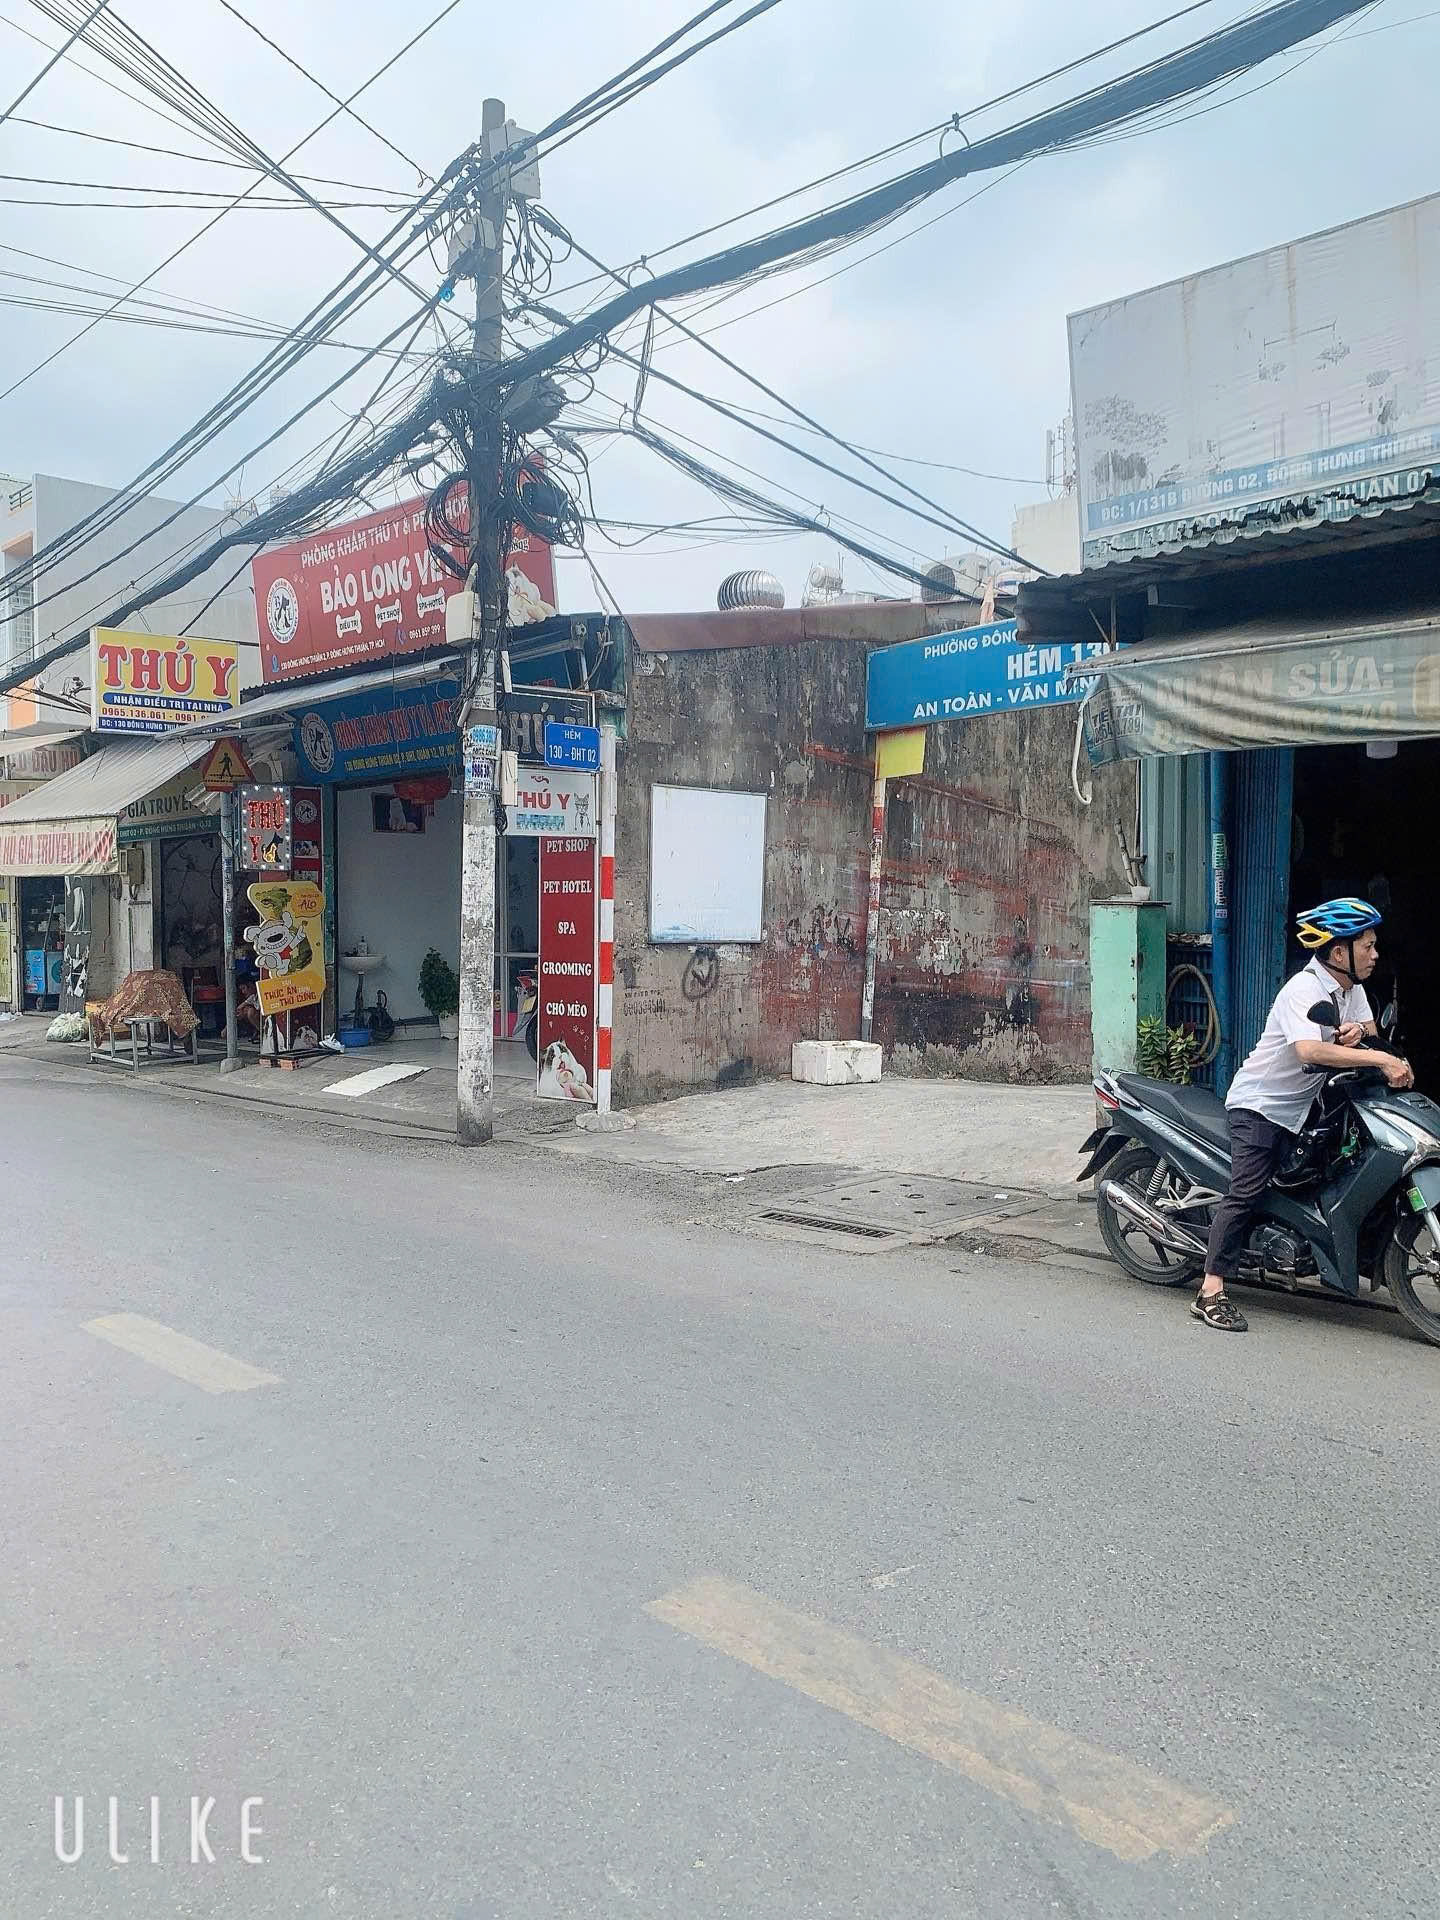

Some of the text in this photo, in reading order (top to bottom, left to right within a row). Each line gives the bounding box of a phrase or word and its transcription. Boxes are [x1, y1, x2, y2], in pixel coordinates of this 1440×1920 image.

[392, 520, 401, 537] Y
[319, 563, 359, 614] BẢO
[359, 555, 413, 603] LONG
[923, 636, 978, 659] PHƯỜNG
[98, 640, 237, 699] THÚ Y
[1007, 644, 1062, 681] HẺM
[113, 695, 143, 709] NHẬN
[913, 702, 938, 719] AN
[942, 690, 992, 714] TOÀN
[1007, 680, 1049, 704] VĂN
[101, 706, 167, 720] 0965.136.061
[175, 712, 198, 722] 0961
[114, 719, 127, 729] 130
[564, 729, 582, 741] HẺM
[549, 744, 563, 760] 130
[571, 747, 586, 762] ĐHT
[587, 749, 597, 763] 02
[127, 800, 148, 819] GIA
[557, 793, 571, 810] Y
[247, 792, 286, 831] THÚ
[248, 835, 261, 863] Y
[546, 838, 590, 853] PET SHOP
[543, 880, 593, 894] PET HOTEL
[557, 921, 577, 935] SPA
[542, 961, 592, 977] GROOMING
[546, 999, 588, 1018] CHÓ MÈO
